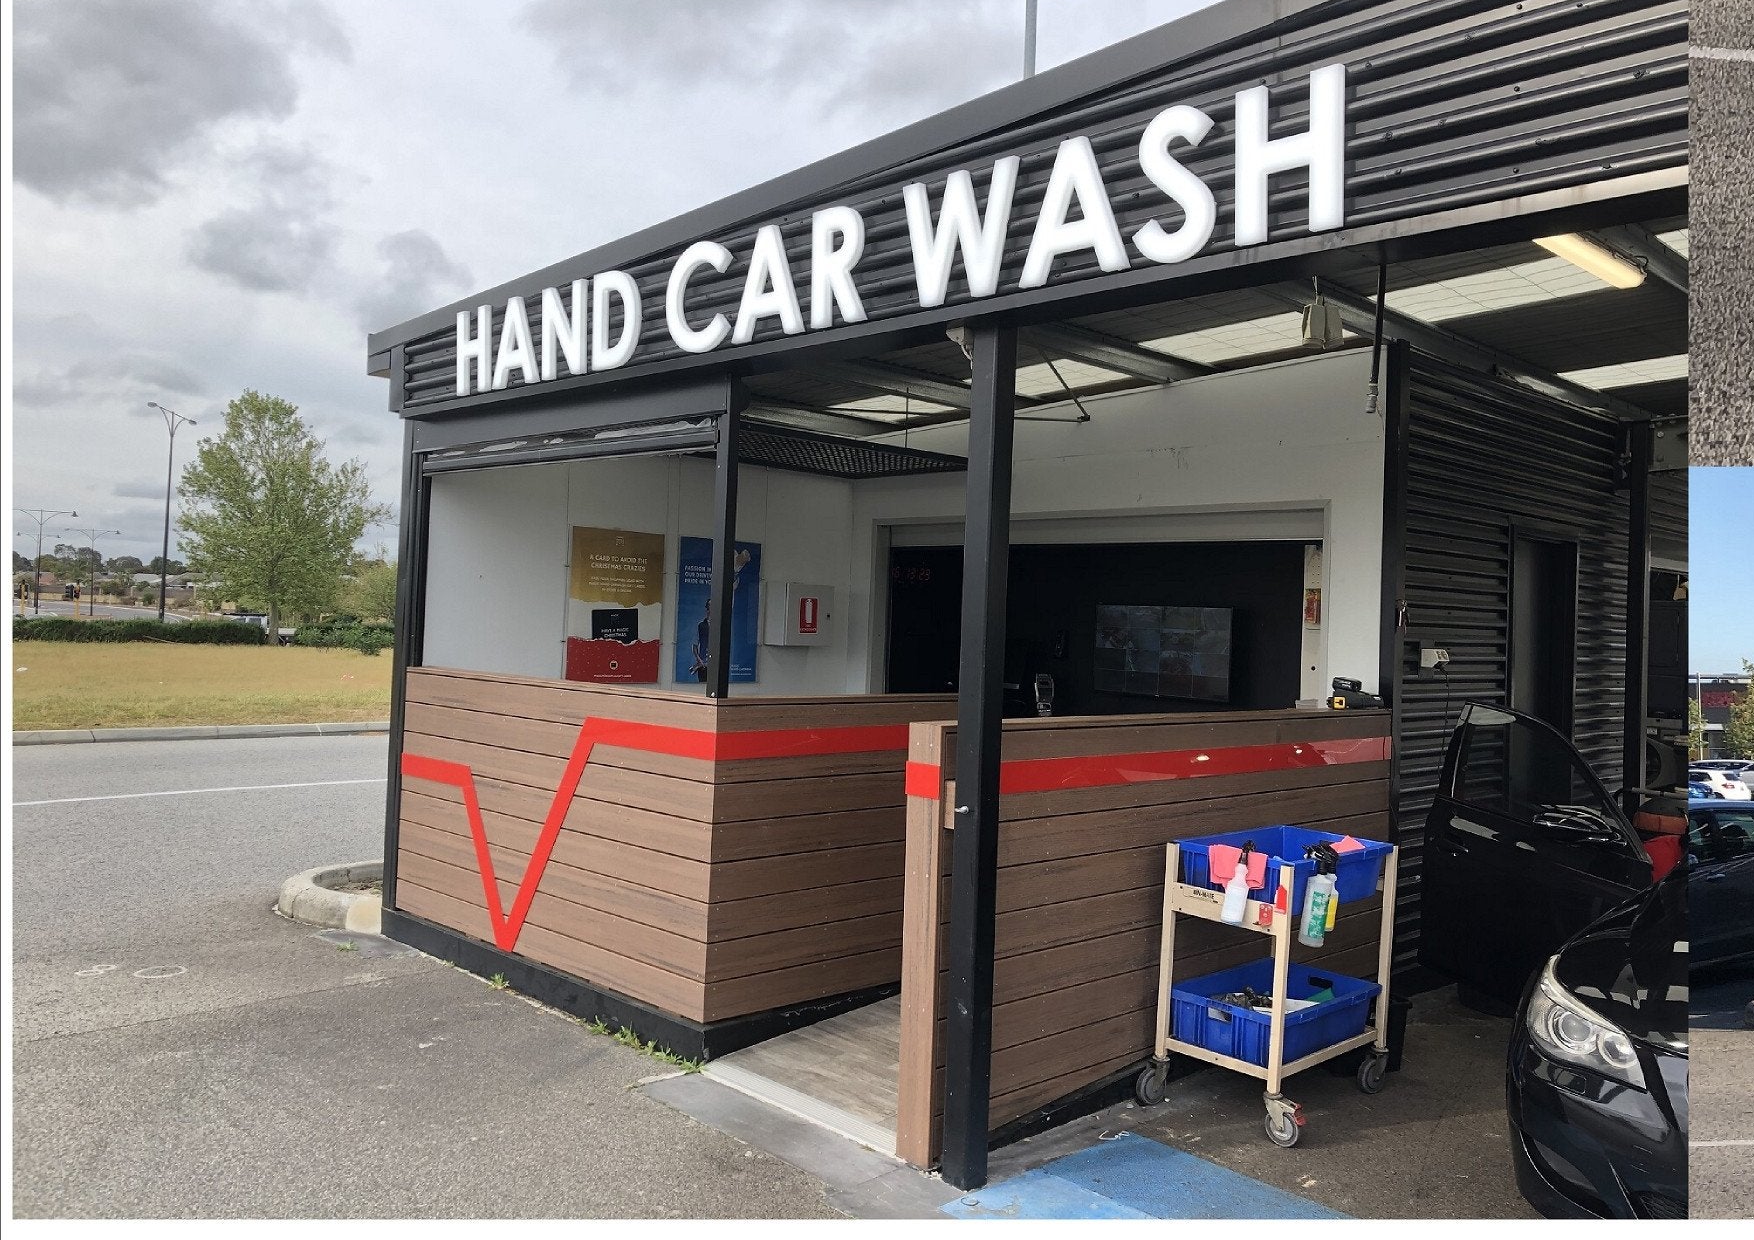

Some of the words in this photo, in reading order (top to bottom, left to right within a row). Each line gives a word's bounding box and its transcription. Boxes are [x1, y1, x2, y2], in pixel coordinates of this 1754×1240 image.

[456, 270, 642, 397] HAND
[665, 206, 869, 354] CAR
[904, 63, 1347, 308] WASH
